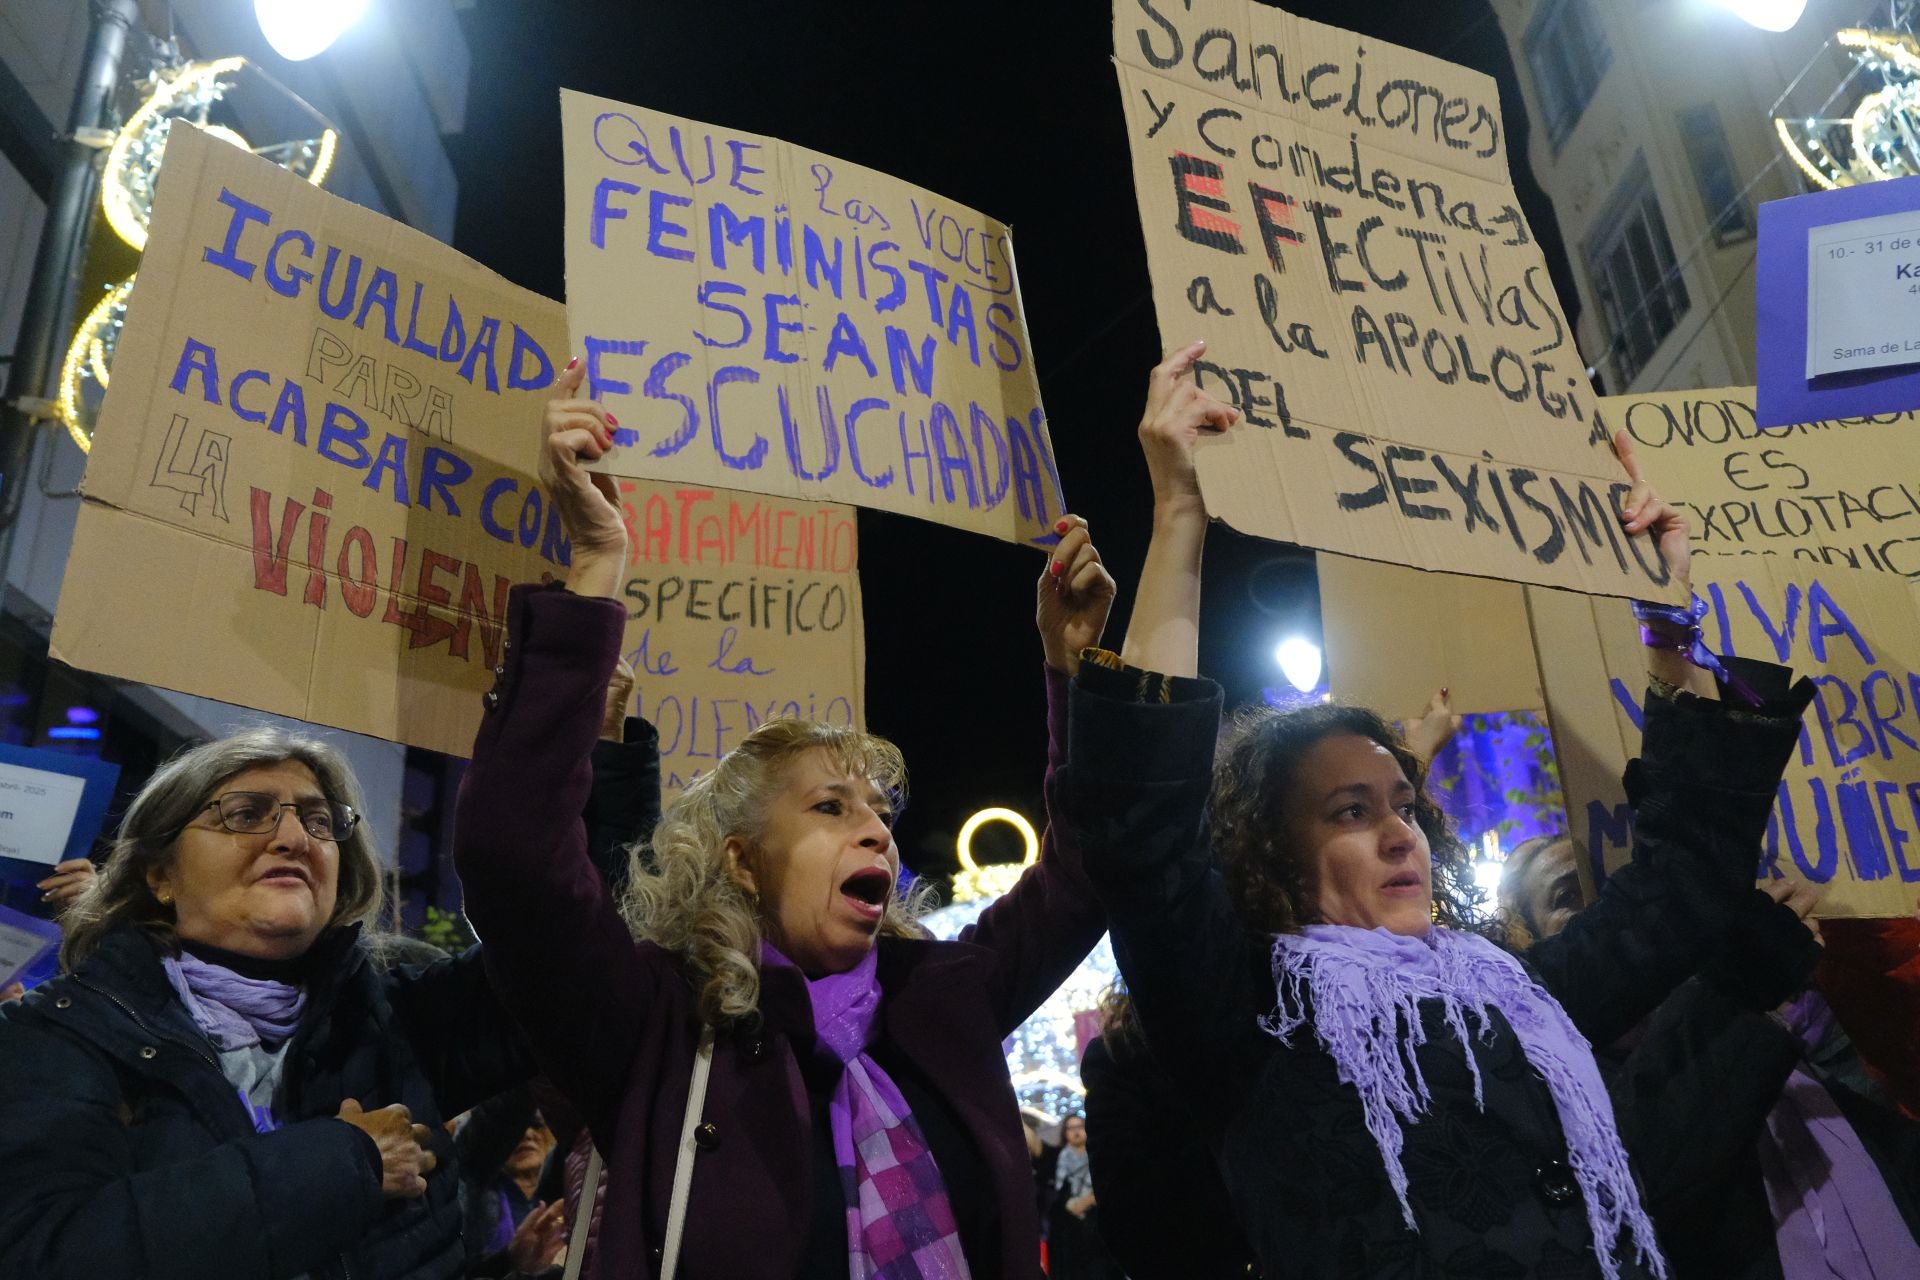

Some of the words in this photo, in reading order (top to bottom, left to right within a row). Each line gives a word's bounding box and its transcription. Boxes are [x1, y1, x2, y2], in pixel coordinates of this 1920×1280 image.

[1136, 0, 1499, 159] Sanciones
[593, 111, 766, 196] QUE
[910, 198, 1015, 296] VOCES
[1864, 240, 1883, 254] 31
[1890, 238, 1911, 250] de
[201, 187, 556, 396] IGUALDAD
[692, 280, 938, 399] SEAN
[1186, 274, 1235, 316] a
[1254, 272, 1329, 360] la
[305, 326, 455, 445] PARA
[1192, 358, 1311, 440] DEL
[1833, 346, 1876, 360] Sama
[1880, 341, 1899, 354] de
[150, 414, 233, 524] LA
[168, 336, 473, 519] ACABAR
[584, 334, 1067, 546] ESCUCHADAS
[1724, 450, 1811, 492] ES
[708, 626, 776, 676] la
[1706, 577, 1878, 666] IVA
